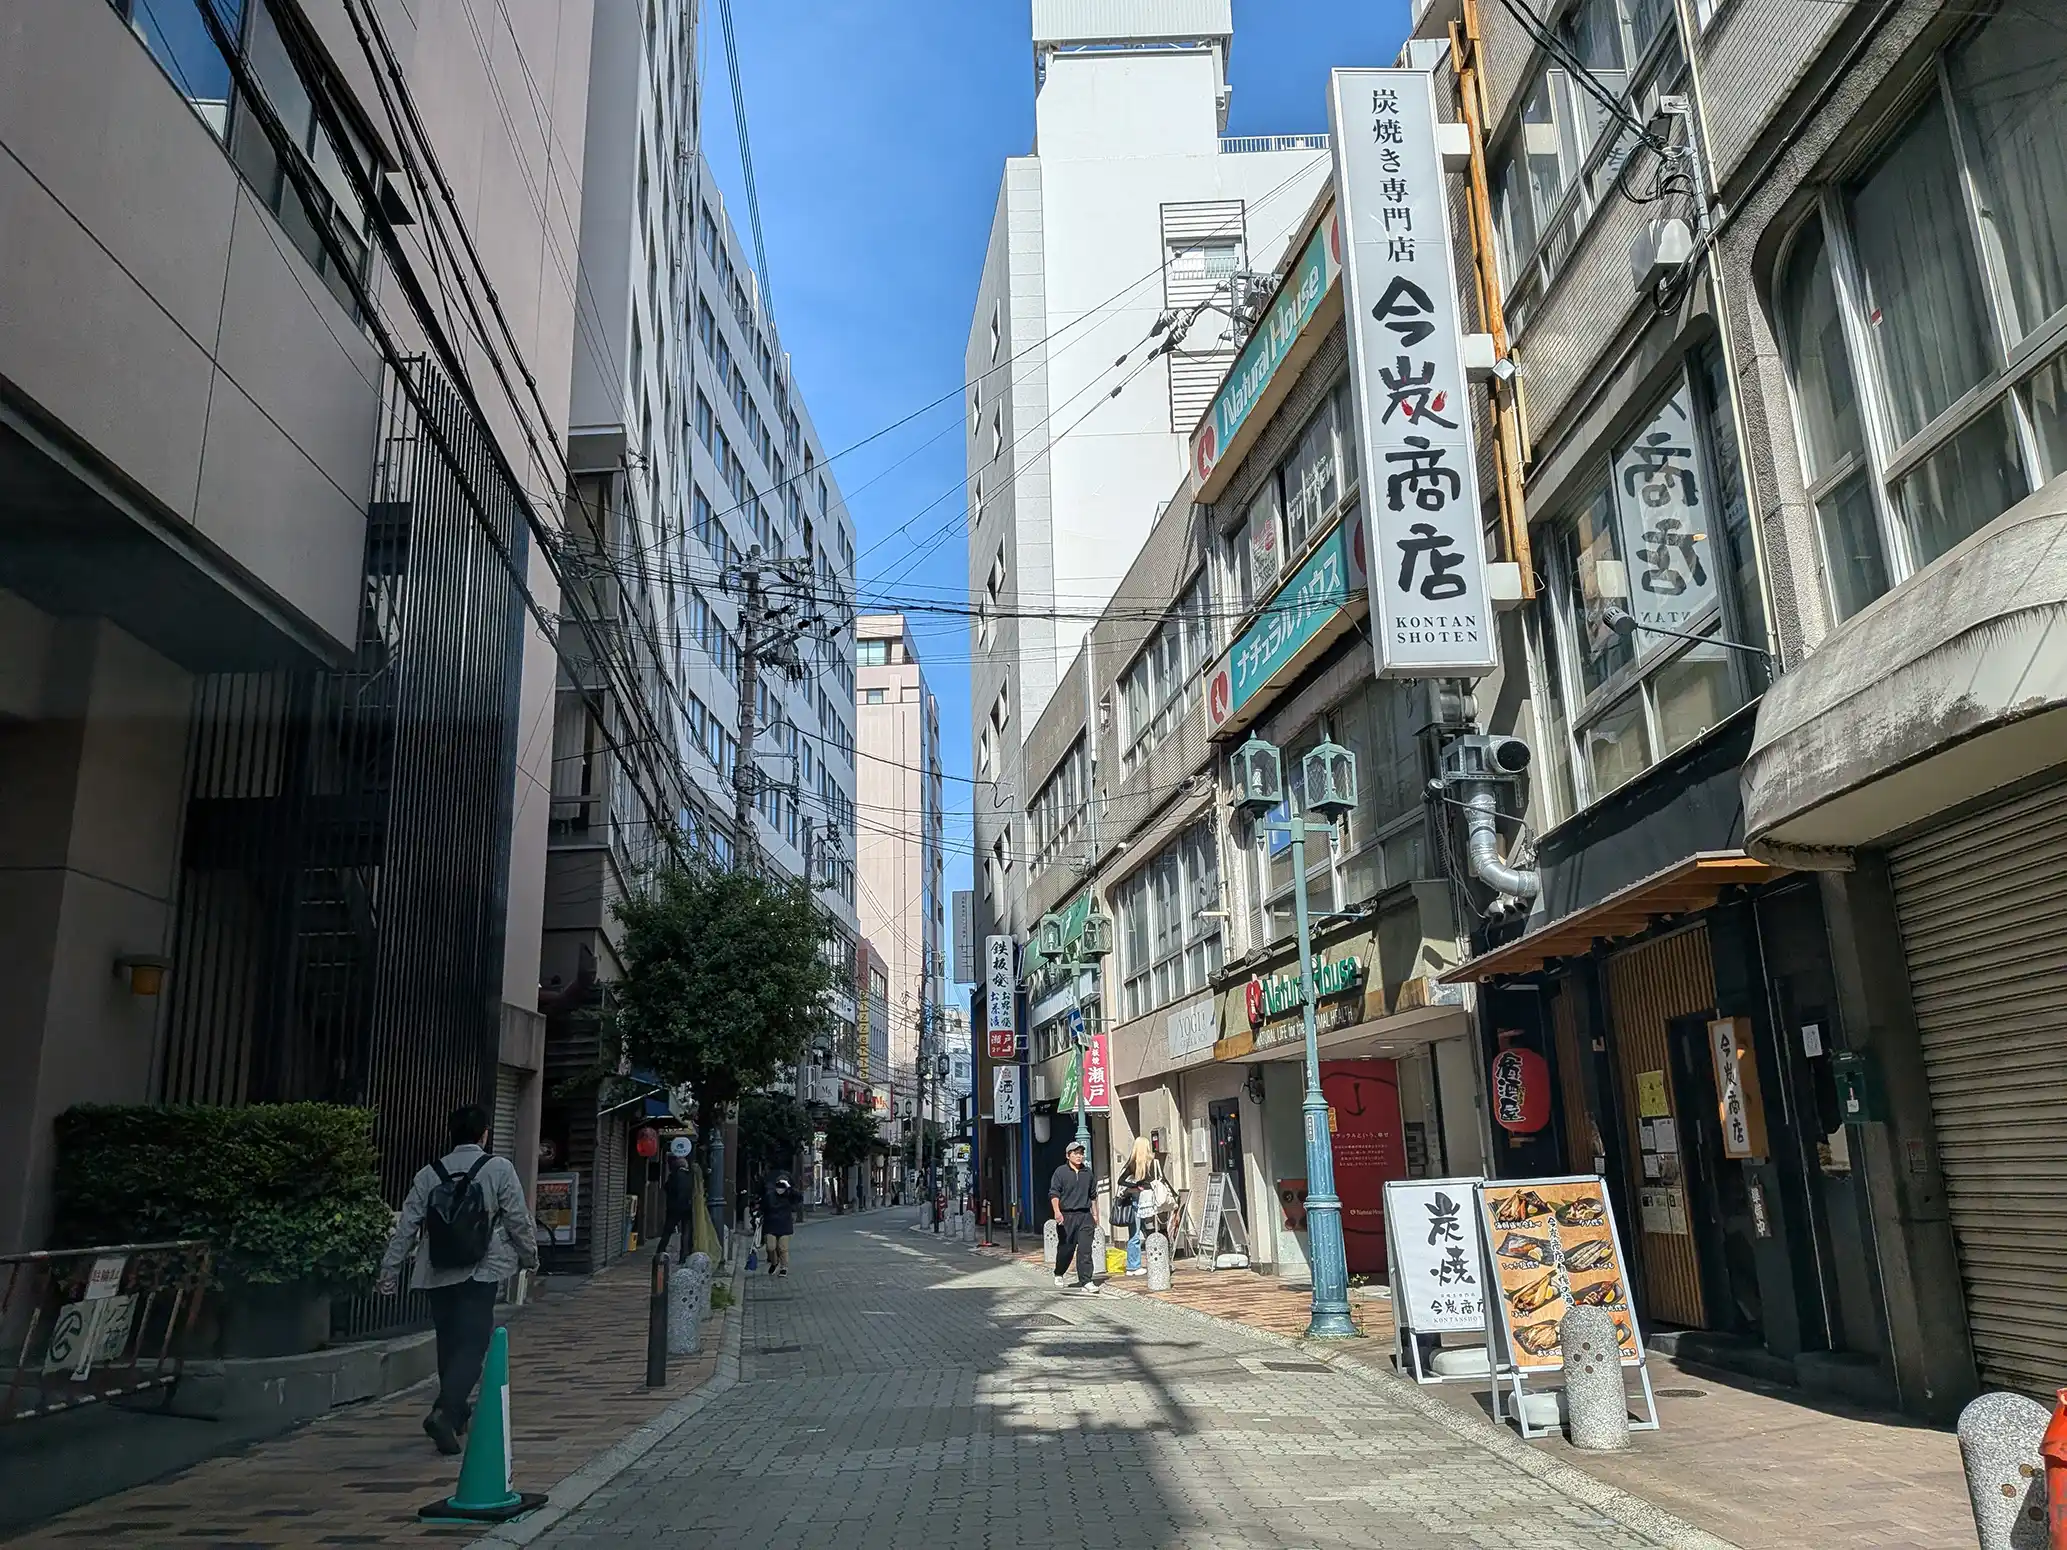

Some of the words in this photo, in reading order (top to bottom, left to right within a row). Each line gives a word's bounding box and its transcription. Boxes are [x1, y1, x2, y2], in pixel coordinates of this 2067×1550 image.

[1371, 88, 1417, 263] 炭焼き専門店
[1222, 336, 1270, 437] Natural
[1269, 264, 1319, 361] House
[1372, 275, 1467, 601] 今炭商店
[1237, 551, 1342, 688] ナチュラルハウス
[1395, 615, 1477, 628] KONTAN
[1397, 631, 1479, 644] SHOTEN
[1088, 1066, 1105, 1102] 瀬戸
[1719, 1033, 1745, 1144] 今炭商店
[1424, 1191, 1475, 1287] 炭焼
